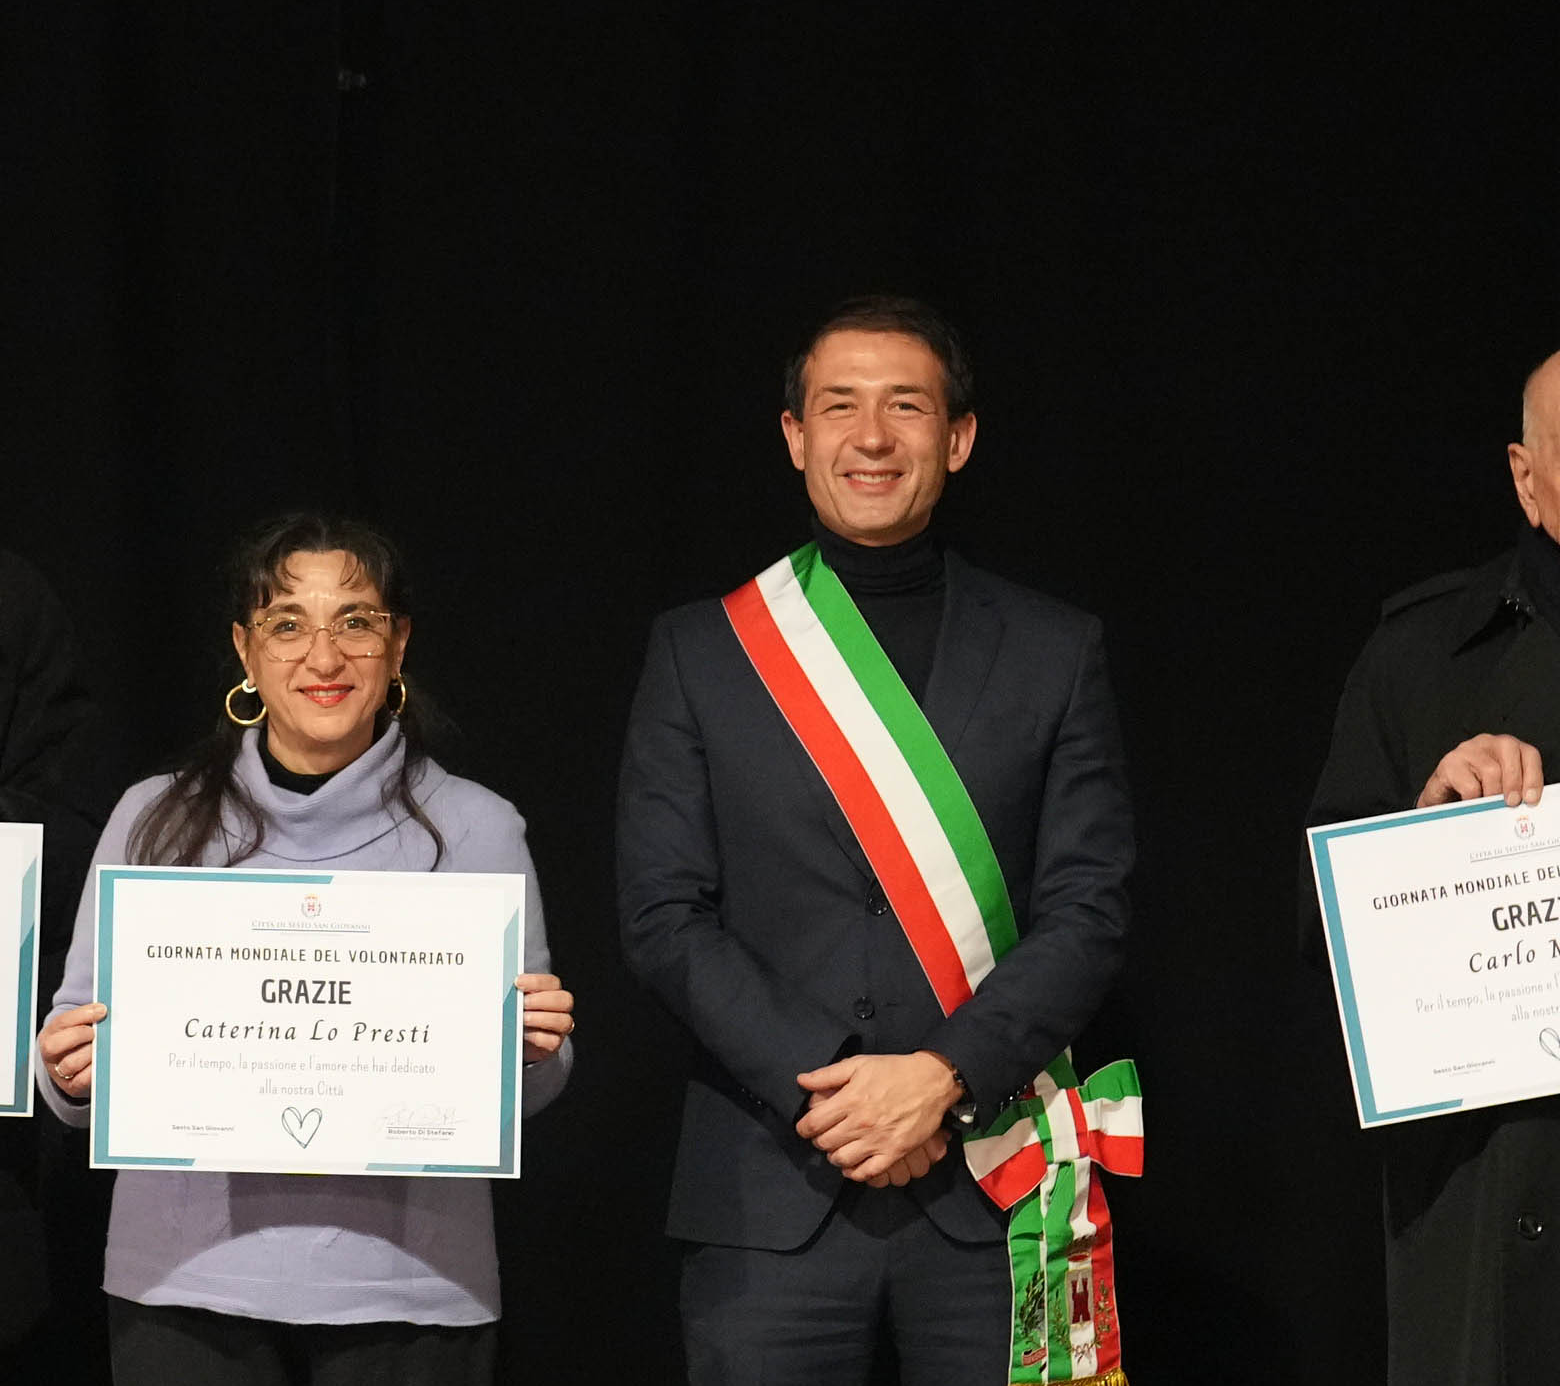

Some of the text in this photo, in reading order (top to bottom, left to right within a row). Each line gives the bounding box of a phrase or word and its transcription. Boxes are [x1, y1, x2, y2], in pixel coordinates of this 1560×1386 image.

[1372, 885, 1448, 911] GIORNATA
[1454, 870, 1531, 896] MONDIALE
[146, 944, 464, 966] GIORNATA MONDIALE DEL VOLONTARIATO
[1468, 939, 1536, 974] Carlo
[261, 978, 352, 1005] GRAZIE
[184, 1017, 430, 1044] Caterina Lo Presti
